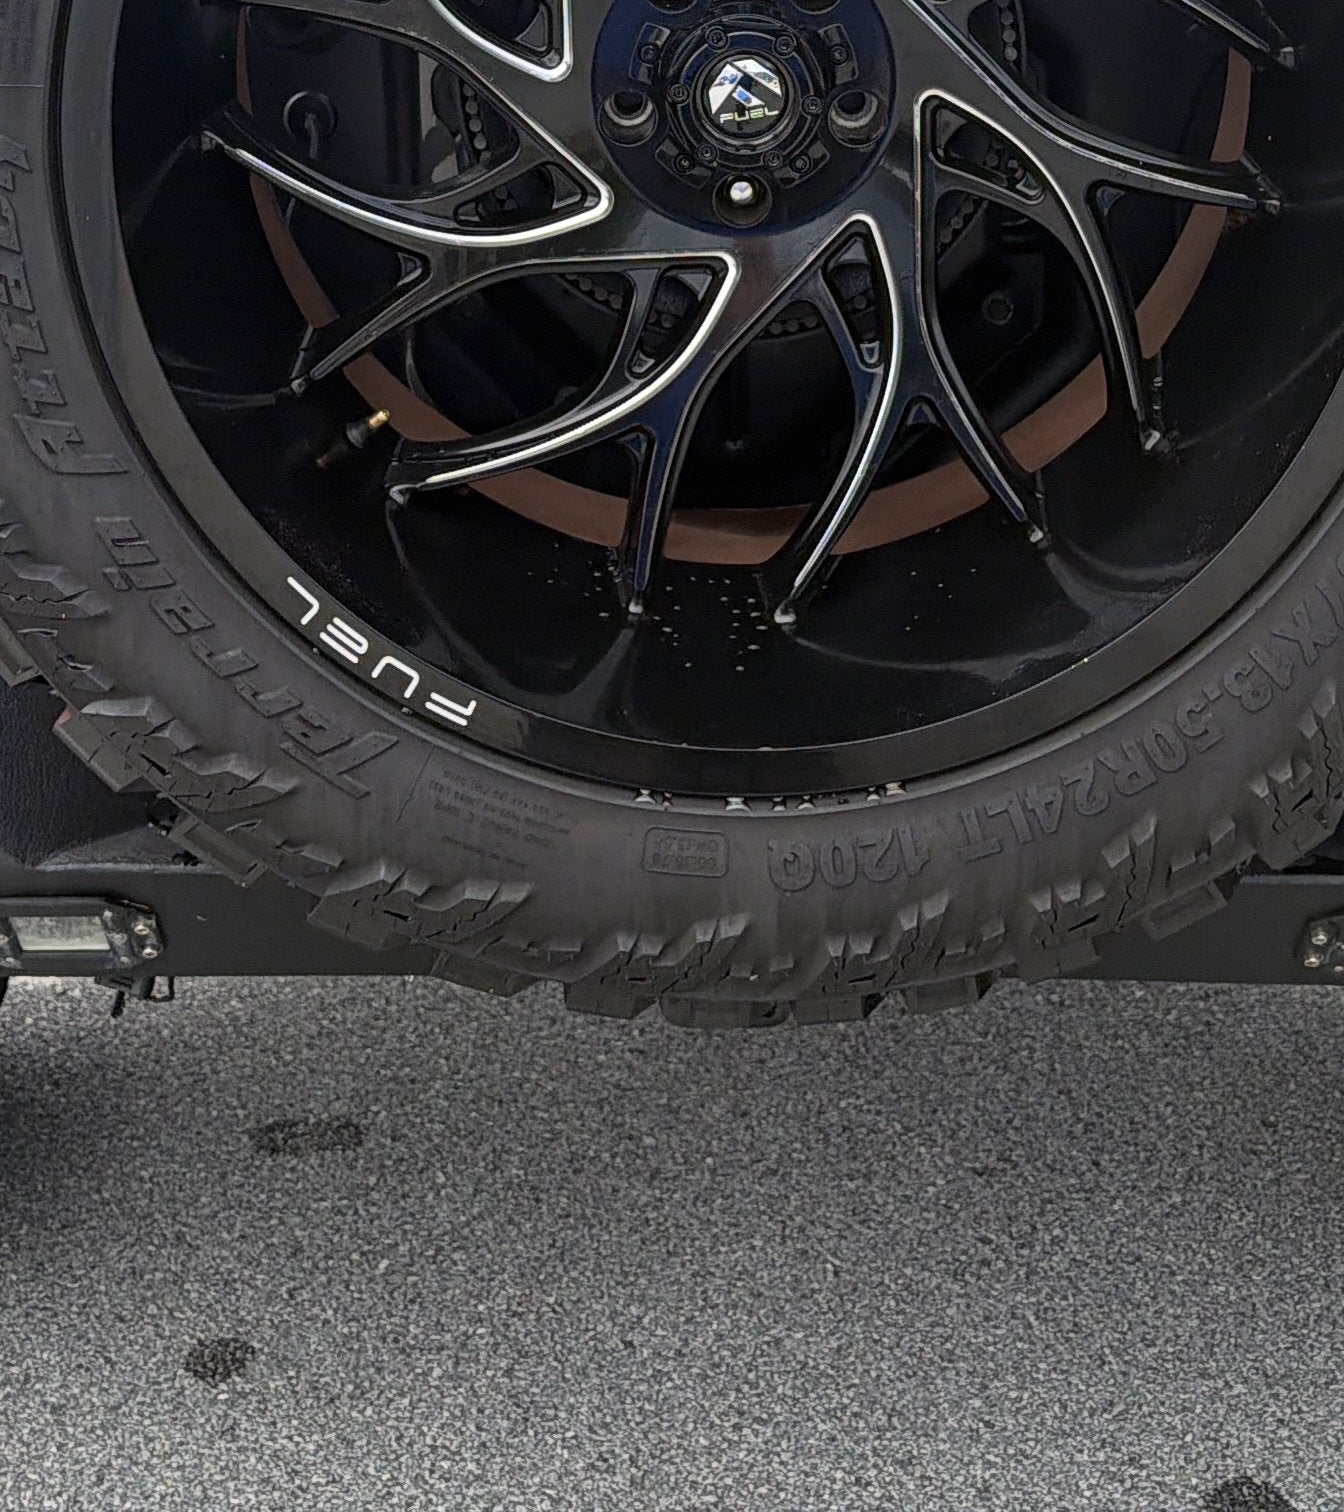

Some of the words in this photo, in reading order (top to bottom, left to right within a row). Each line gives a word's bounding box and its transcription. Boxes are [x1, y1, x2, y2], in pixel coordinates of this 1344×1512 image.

[719, 107, 780, 125] FUEL
[286, 575, 477, 727] FUEL
[768, 821, 932, 894] 120Q
